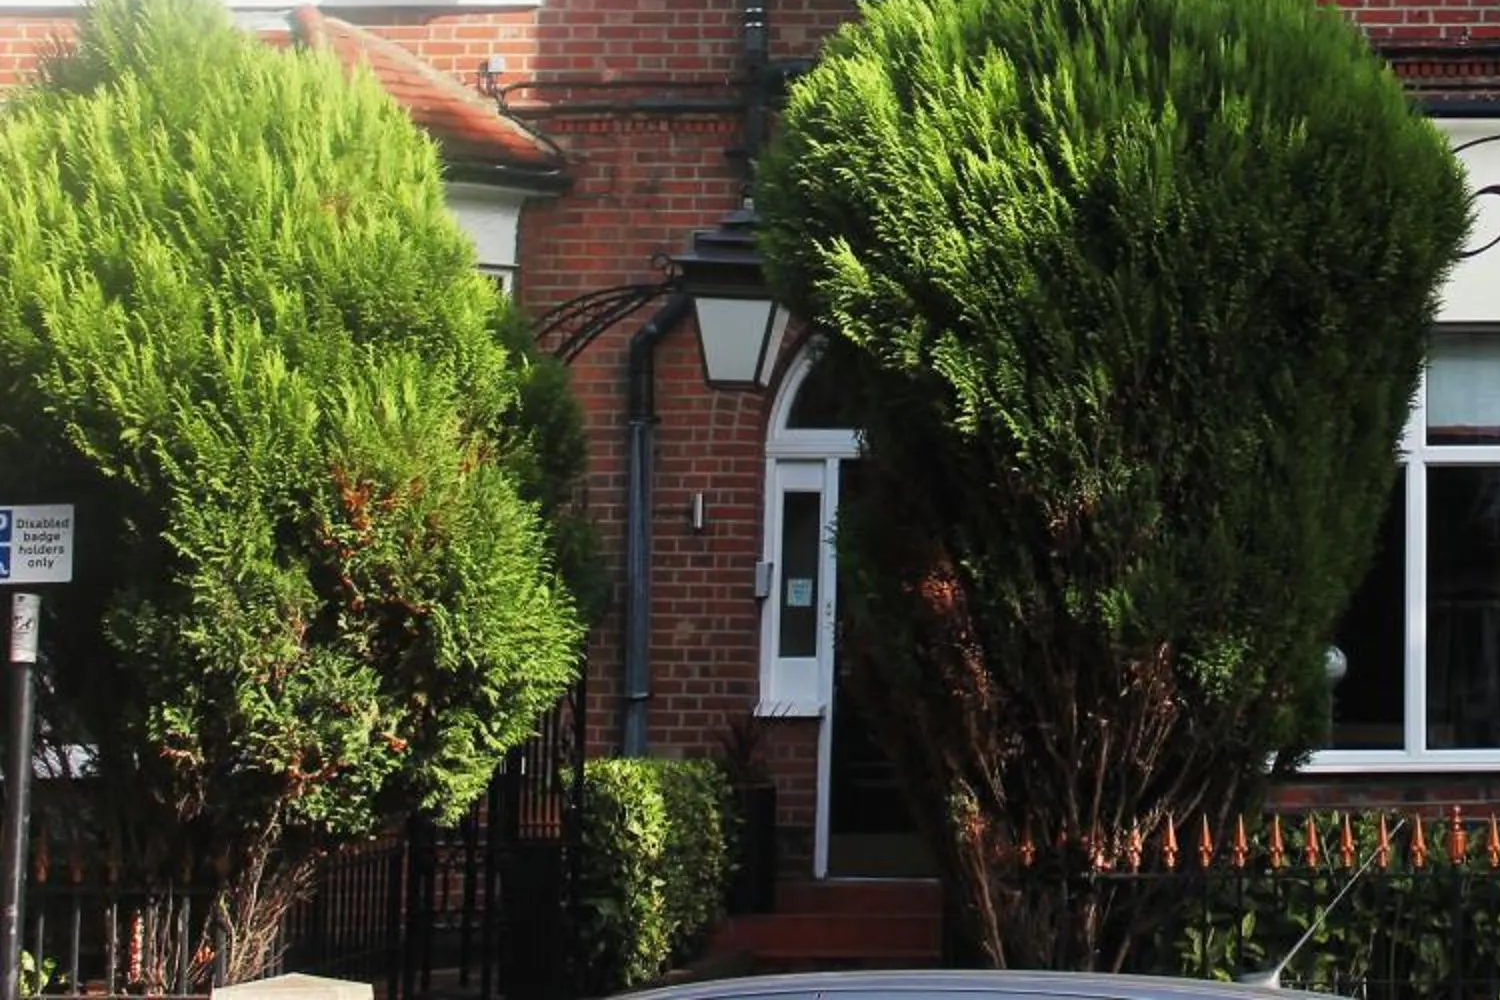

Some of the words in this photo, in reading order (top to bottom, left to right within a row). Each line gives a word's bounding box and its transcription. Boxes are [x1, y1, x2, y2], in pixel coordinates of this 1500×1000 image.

[16, 518, 69, 529] Disabled
[23, 531, 60, 542] badge
[18, 545, 64, 554] holders
[27, 558, 54, 569] only
